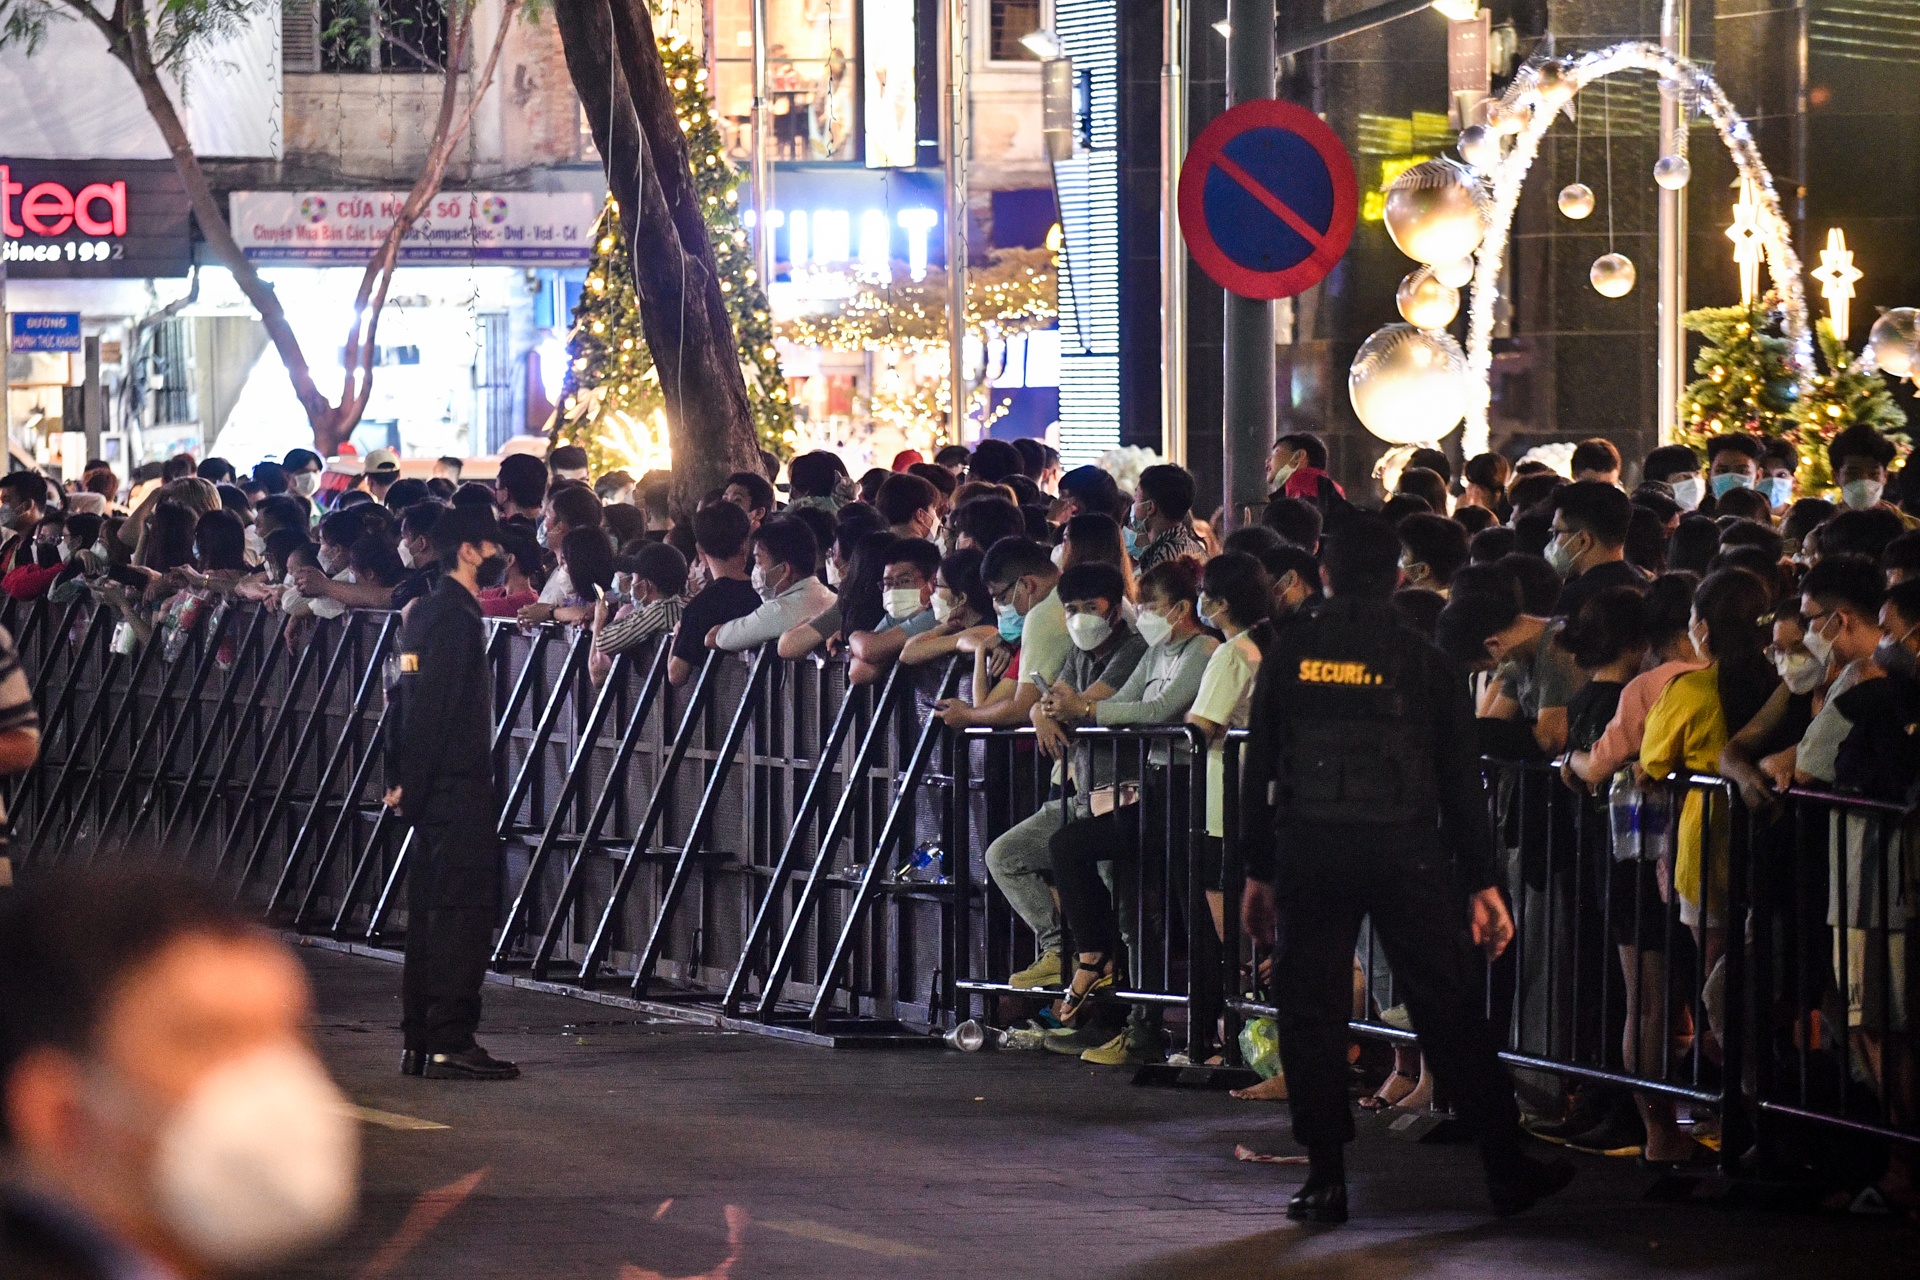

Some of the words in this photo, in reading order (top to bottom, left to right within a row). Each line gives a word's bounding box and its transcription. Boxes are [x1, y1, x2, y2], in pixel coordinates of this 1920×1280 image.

[0, 164, 127, 238] tea
[336, 194, 374, 218] CỬA
[436, 195, 461, 218] SỐ
[295, 225, 318, 240] Mua
[322, 223, 342, 240] Bán
[345, 223, 366, 240] Các
[422, 226, 469, 242] Compact
[471, 225, 495, 240] Disc
[504, 225, 524, 240] Dvd
[533, 225, 553, 240] Vcd
[563, 225, 577, 240] Cd
[2, 240, 61, 262] Since
[64, 241, 124, 262] 1992
